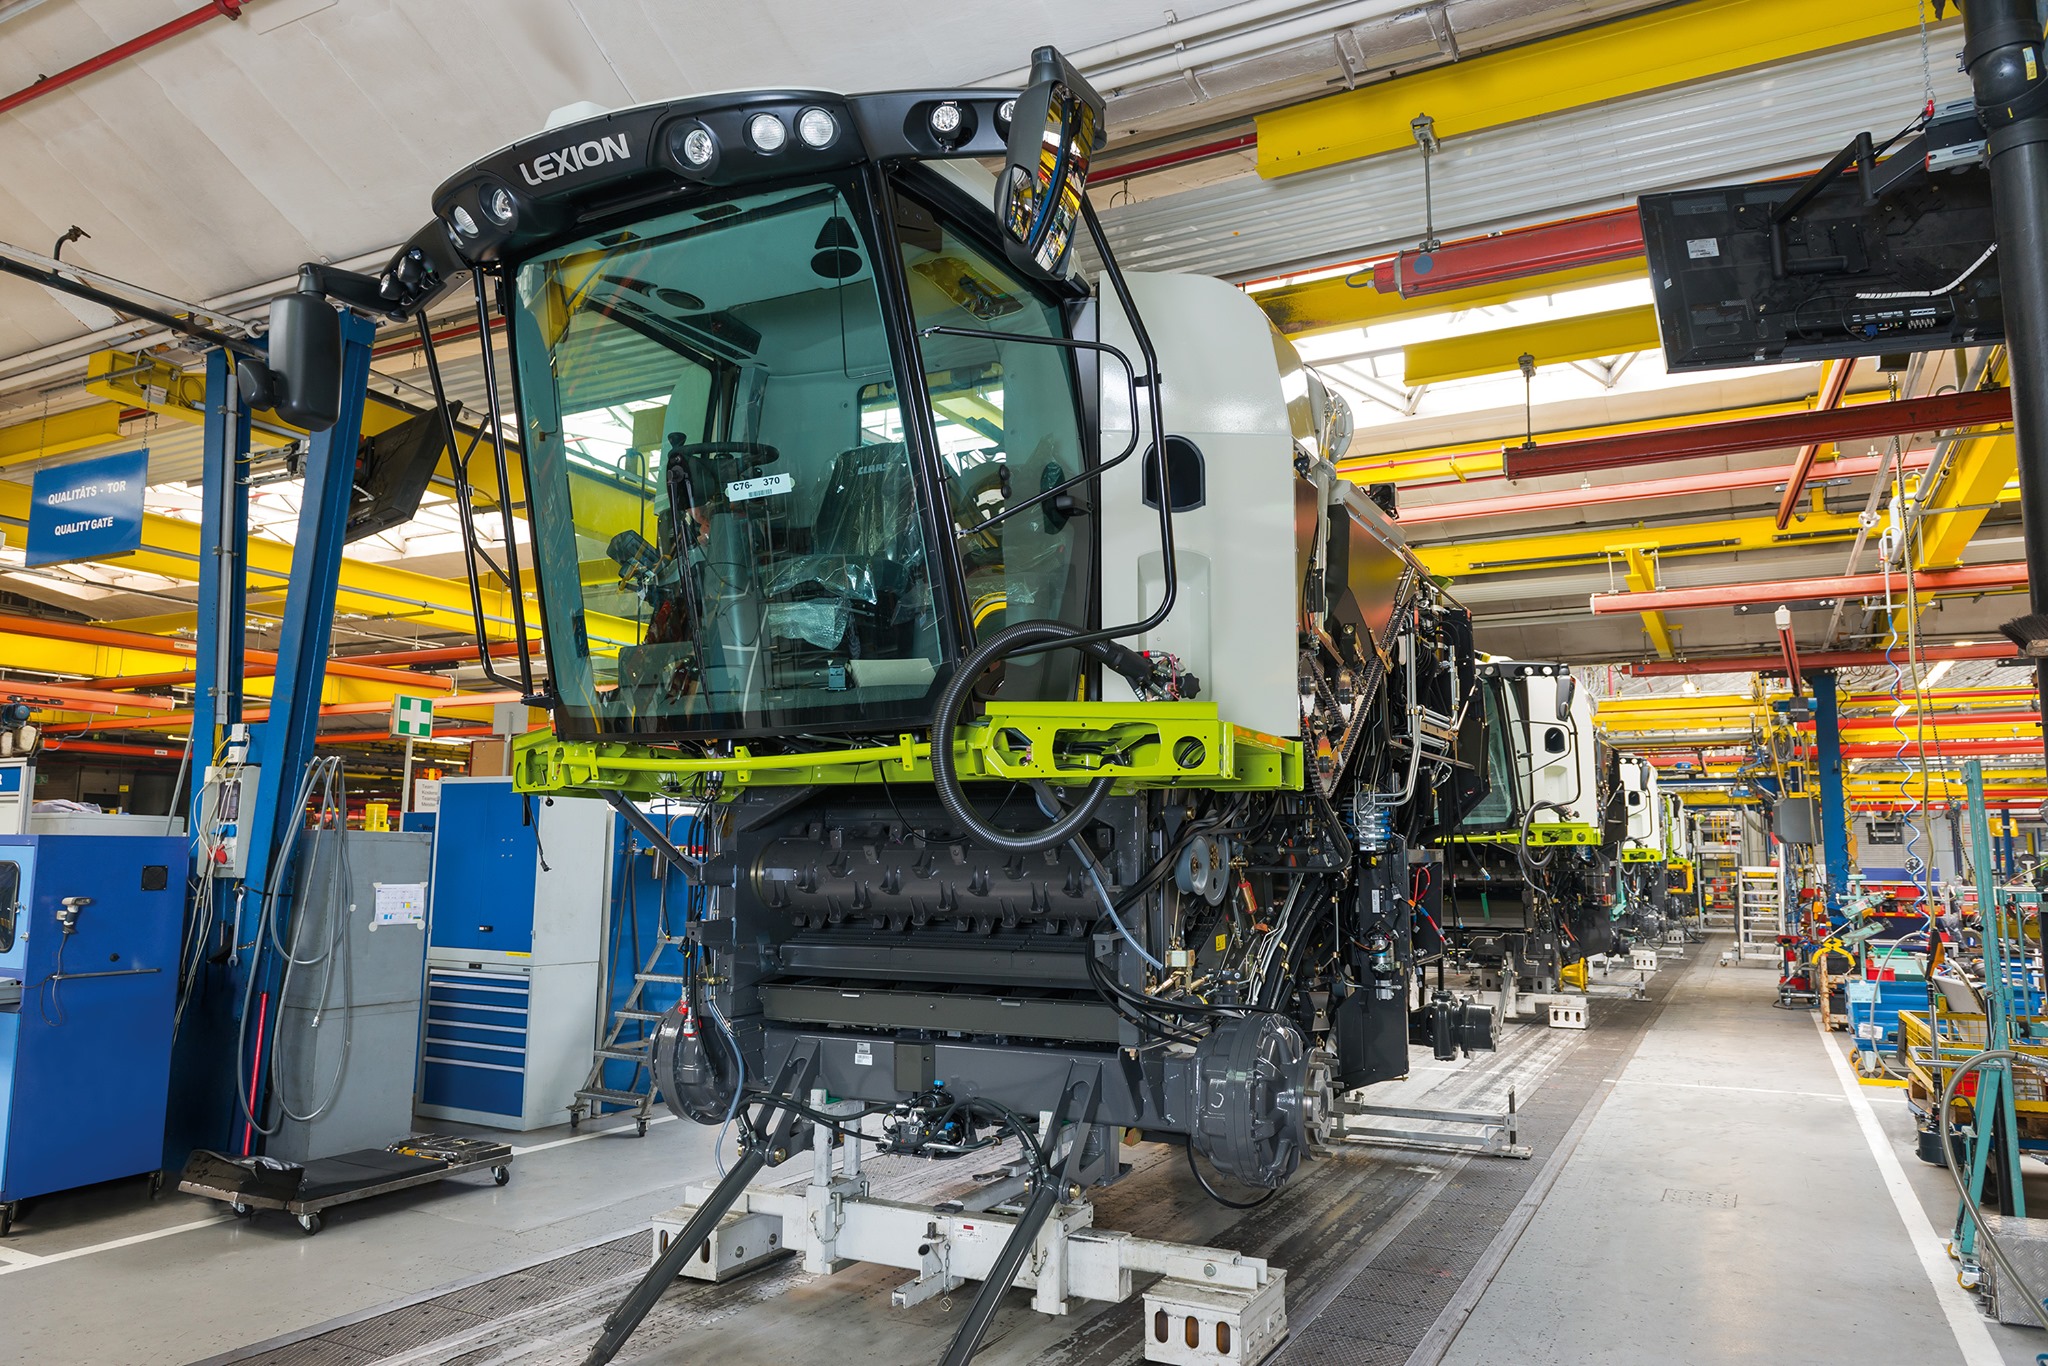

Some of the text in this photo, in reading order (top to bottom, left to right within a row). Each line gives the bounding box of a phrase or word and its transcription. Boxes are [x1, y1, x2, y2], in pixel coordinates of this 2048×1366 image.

[519, 133, 631, 186] LEXION
[48, 485, 97, 505] QUALITÄTS
[107, 480, 127, 494] TOR
[733, 476, 780, 491] C76- 370
[54, 516, 114, 536] QUALITY GATE
